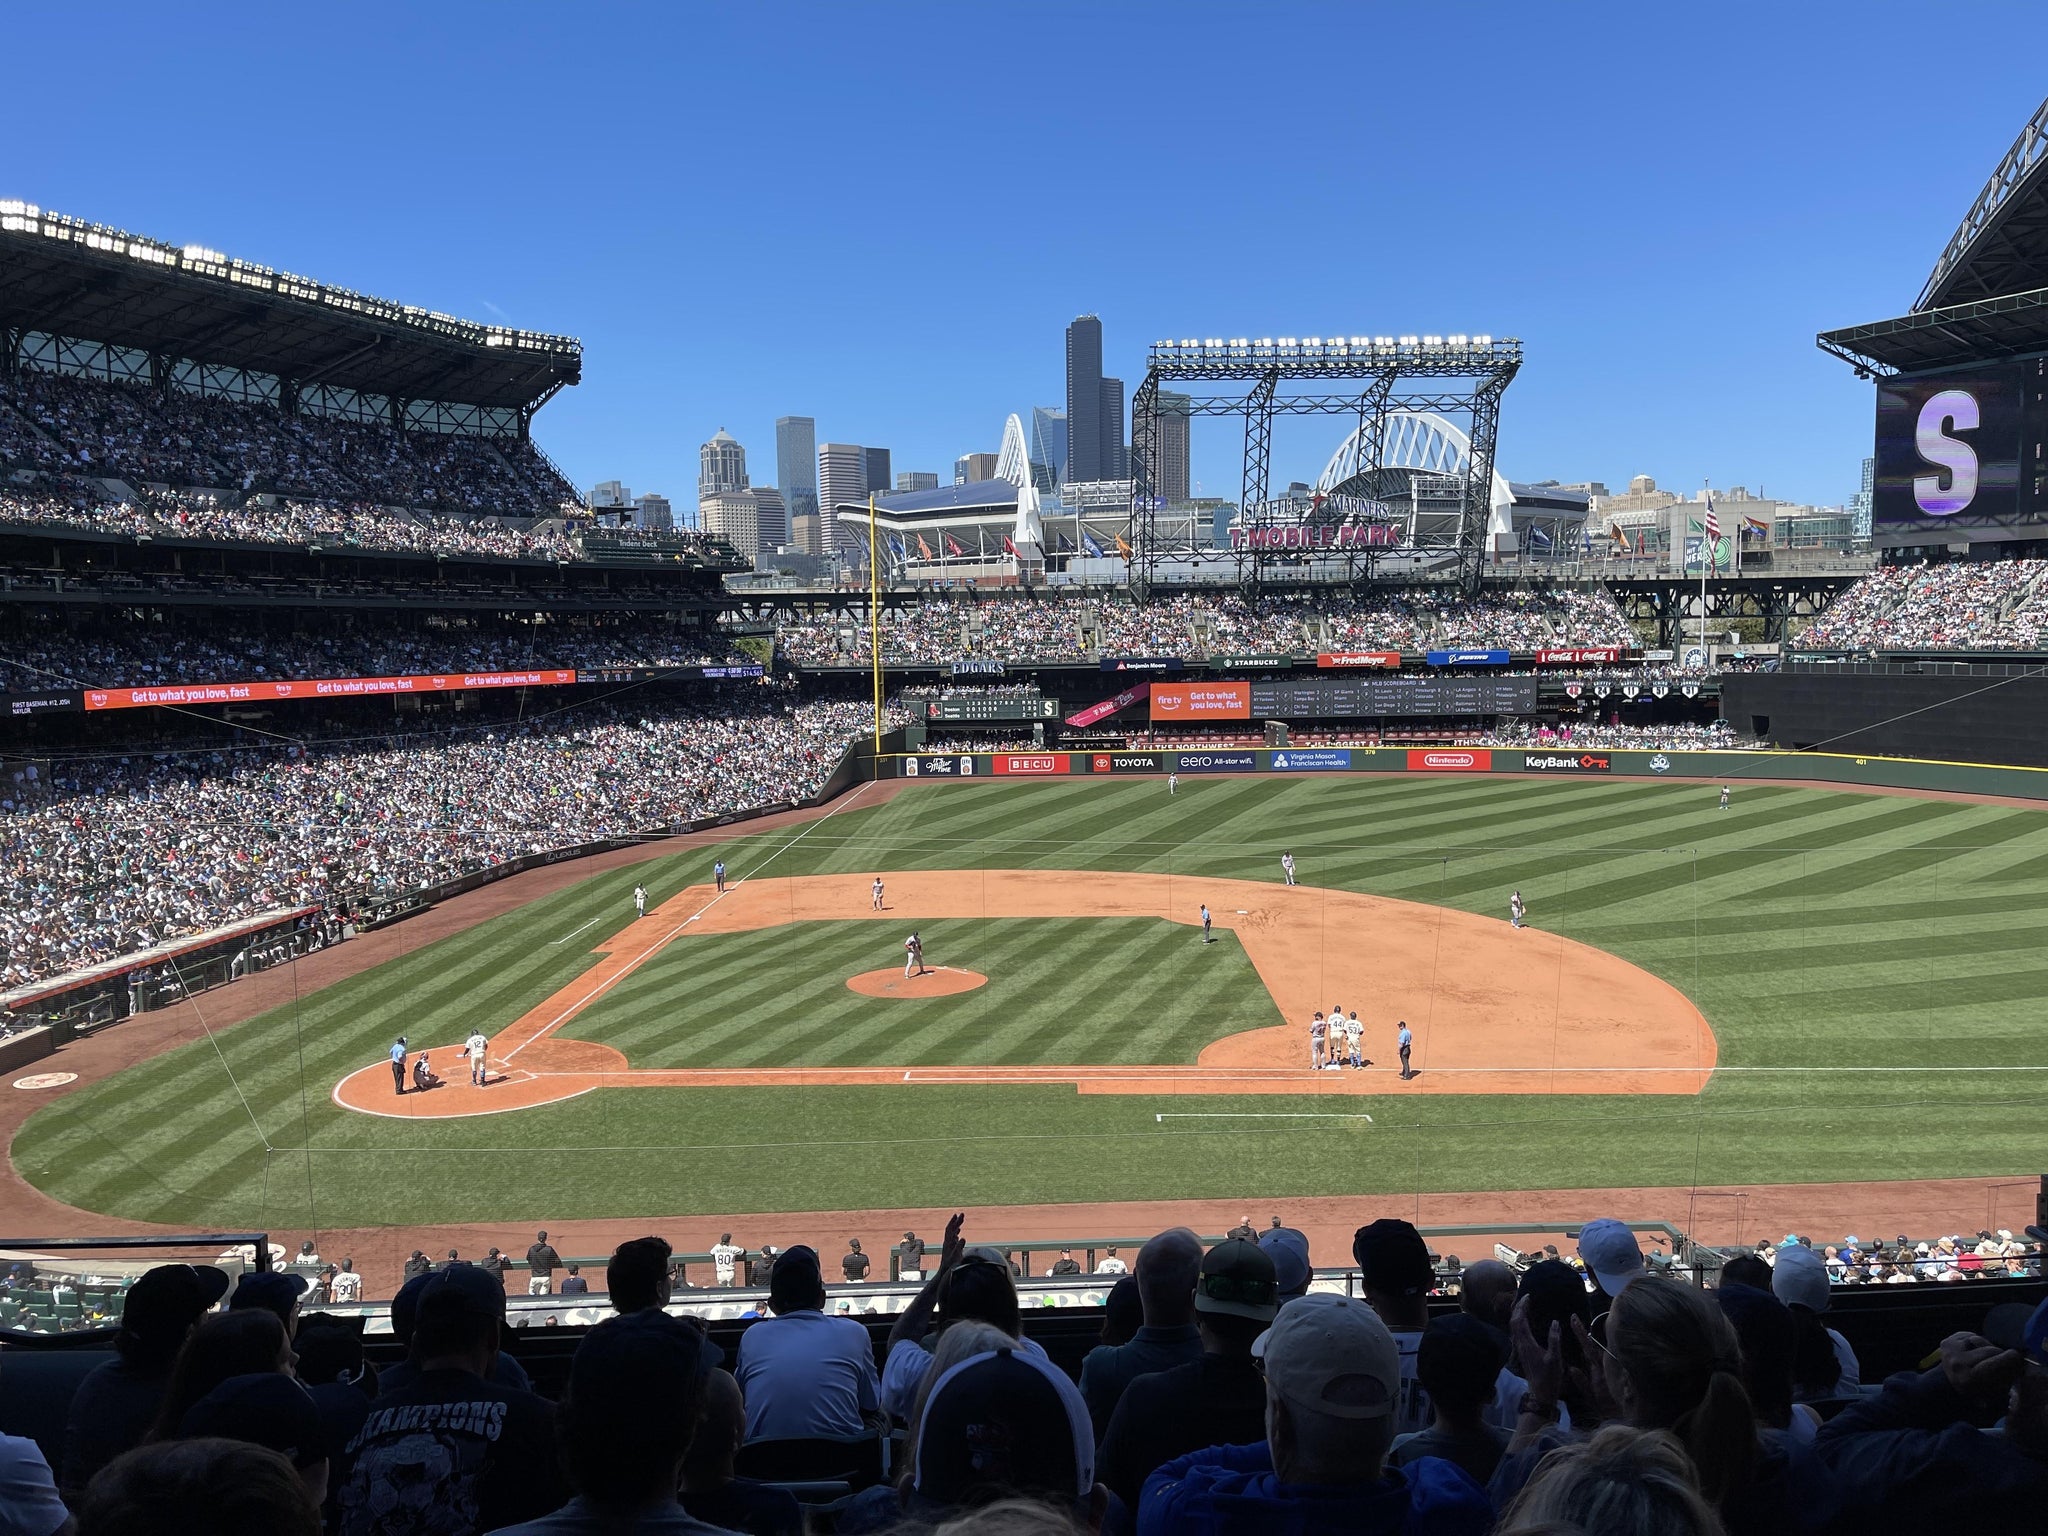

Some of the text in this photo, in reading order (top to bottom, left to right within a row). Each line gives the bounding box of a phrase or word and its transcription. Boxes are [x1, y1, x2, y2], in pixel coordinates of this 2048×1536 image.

[1914, 390, 1979, 515] S
[1330, 494, 1390, 520] MARINERS
[1227, 524, 1401, 548] T-MOBILE PARK
[464, 677, 476, 686] Get
[485, 676, 500, 684] what
[502, 676, 512, 686] you
[513, 674, 527, 684] love,
[528, 674, 541, 682] fast
[316, 680, 412, 693] Get to what you love, fast
[1628, 686, 1635, 695] 11
[1656, 686, 1665, 695] 51
[1686, 686, 1695, 695] 51
[132, 687, 249, 703] Get to what you love, fast
[1158, 696, 1173, 704] fire
[1044, 701, 1052, 715] S
[1226, 700, 1242, 708] fast
[1180, 756, 1212, 766] eero
[1526, 757, 1579, 769] KeyBank
[670, 823, 693, 834] STIHL
[555, 850, 581, 859] LEXUS
[718, 1254, 730, 1265] 80
[339, 1284, 352, 1295] 30
